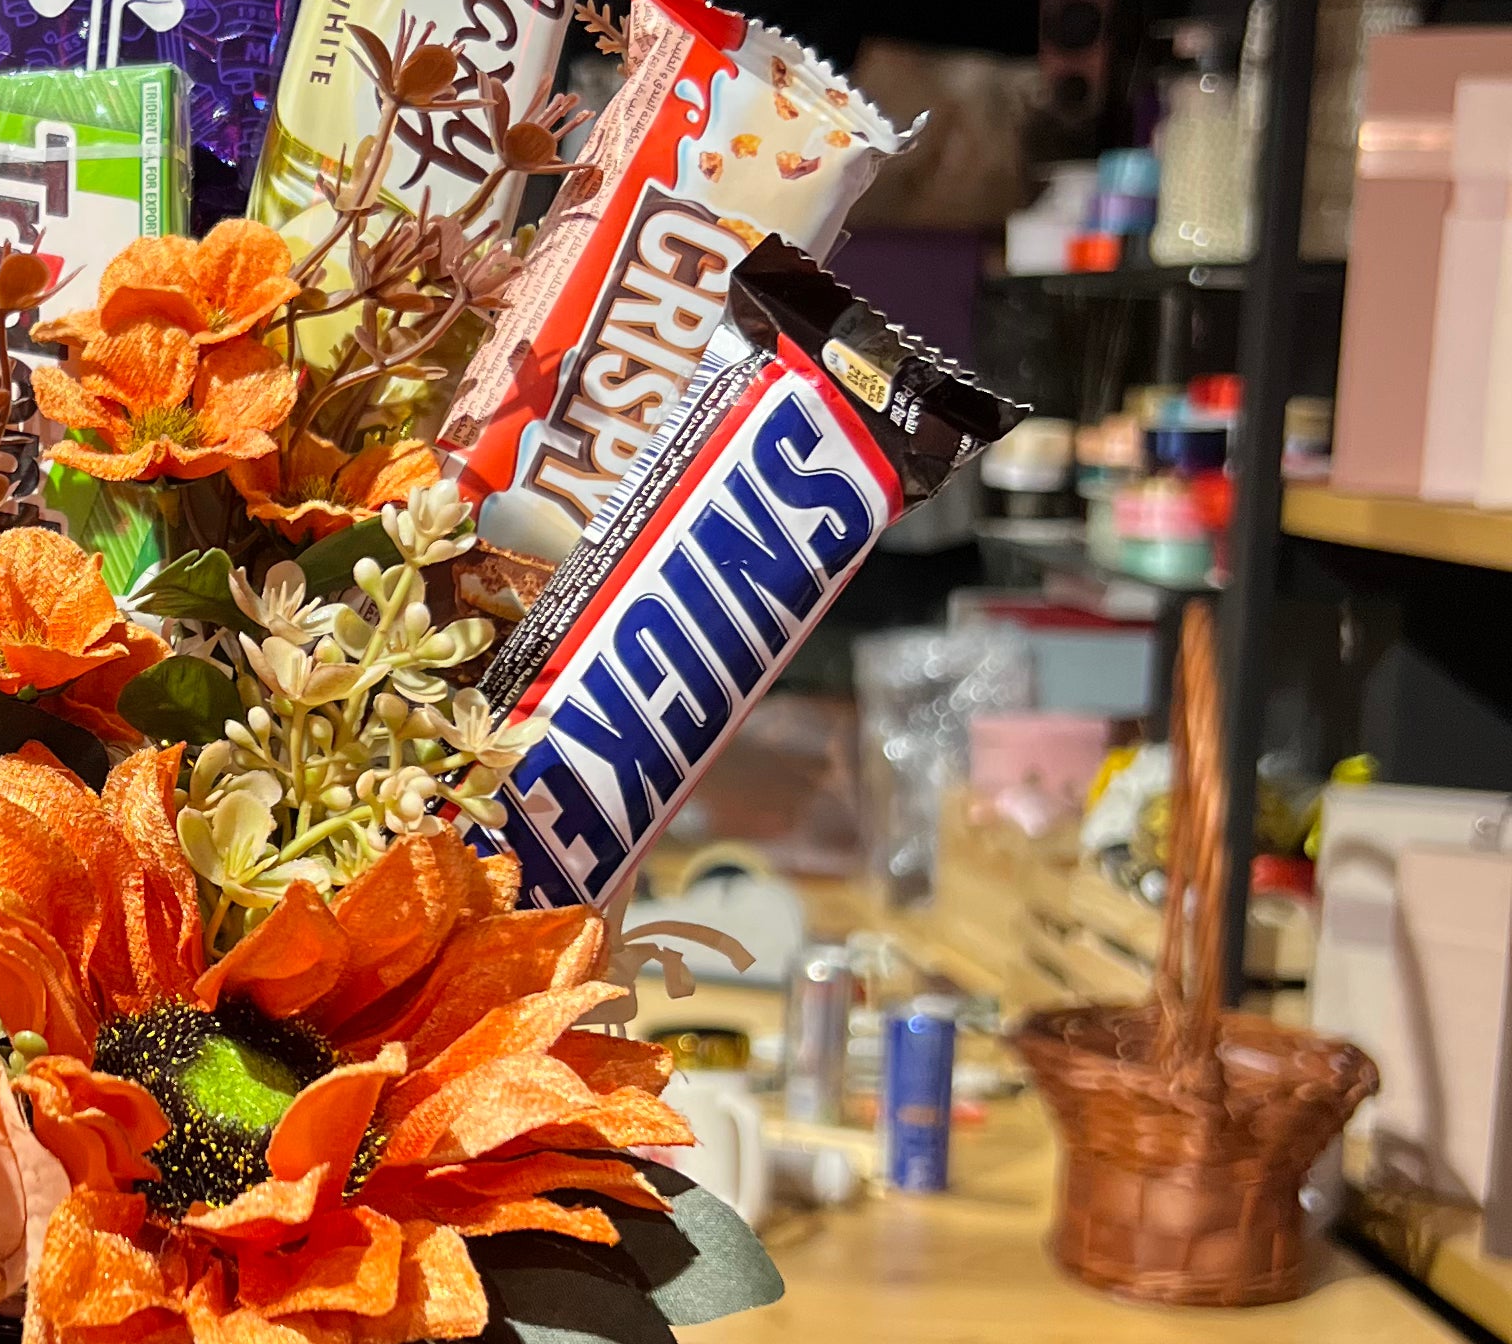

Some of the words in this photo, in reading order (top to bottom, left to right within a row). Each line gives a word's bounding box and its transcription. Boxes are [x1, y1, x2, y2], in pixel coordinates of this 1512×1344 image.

[145, 85, 157, 132] TRIDENT
[144, 166, 157, 189] FOR
[145, 192, 157, 237] EXPORT
[532, 211, 734, 522] CRISPY
[466, 390, 877, 909] SNICKER
